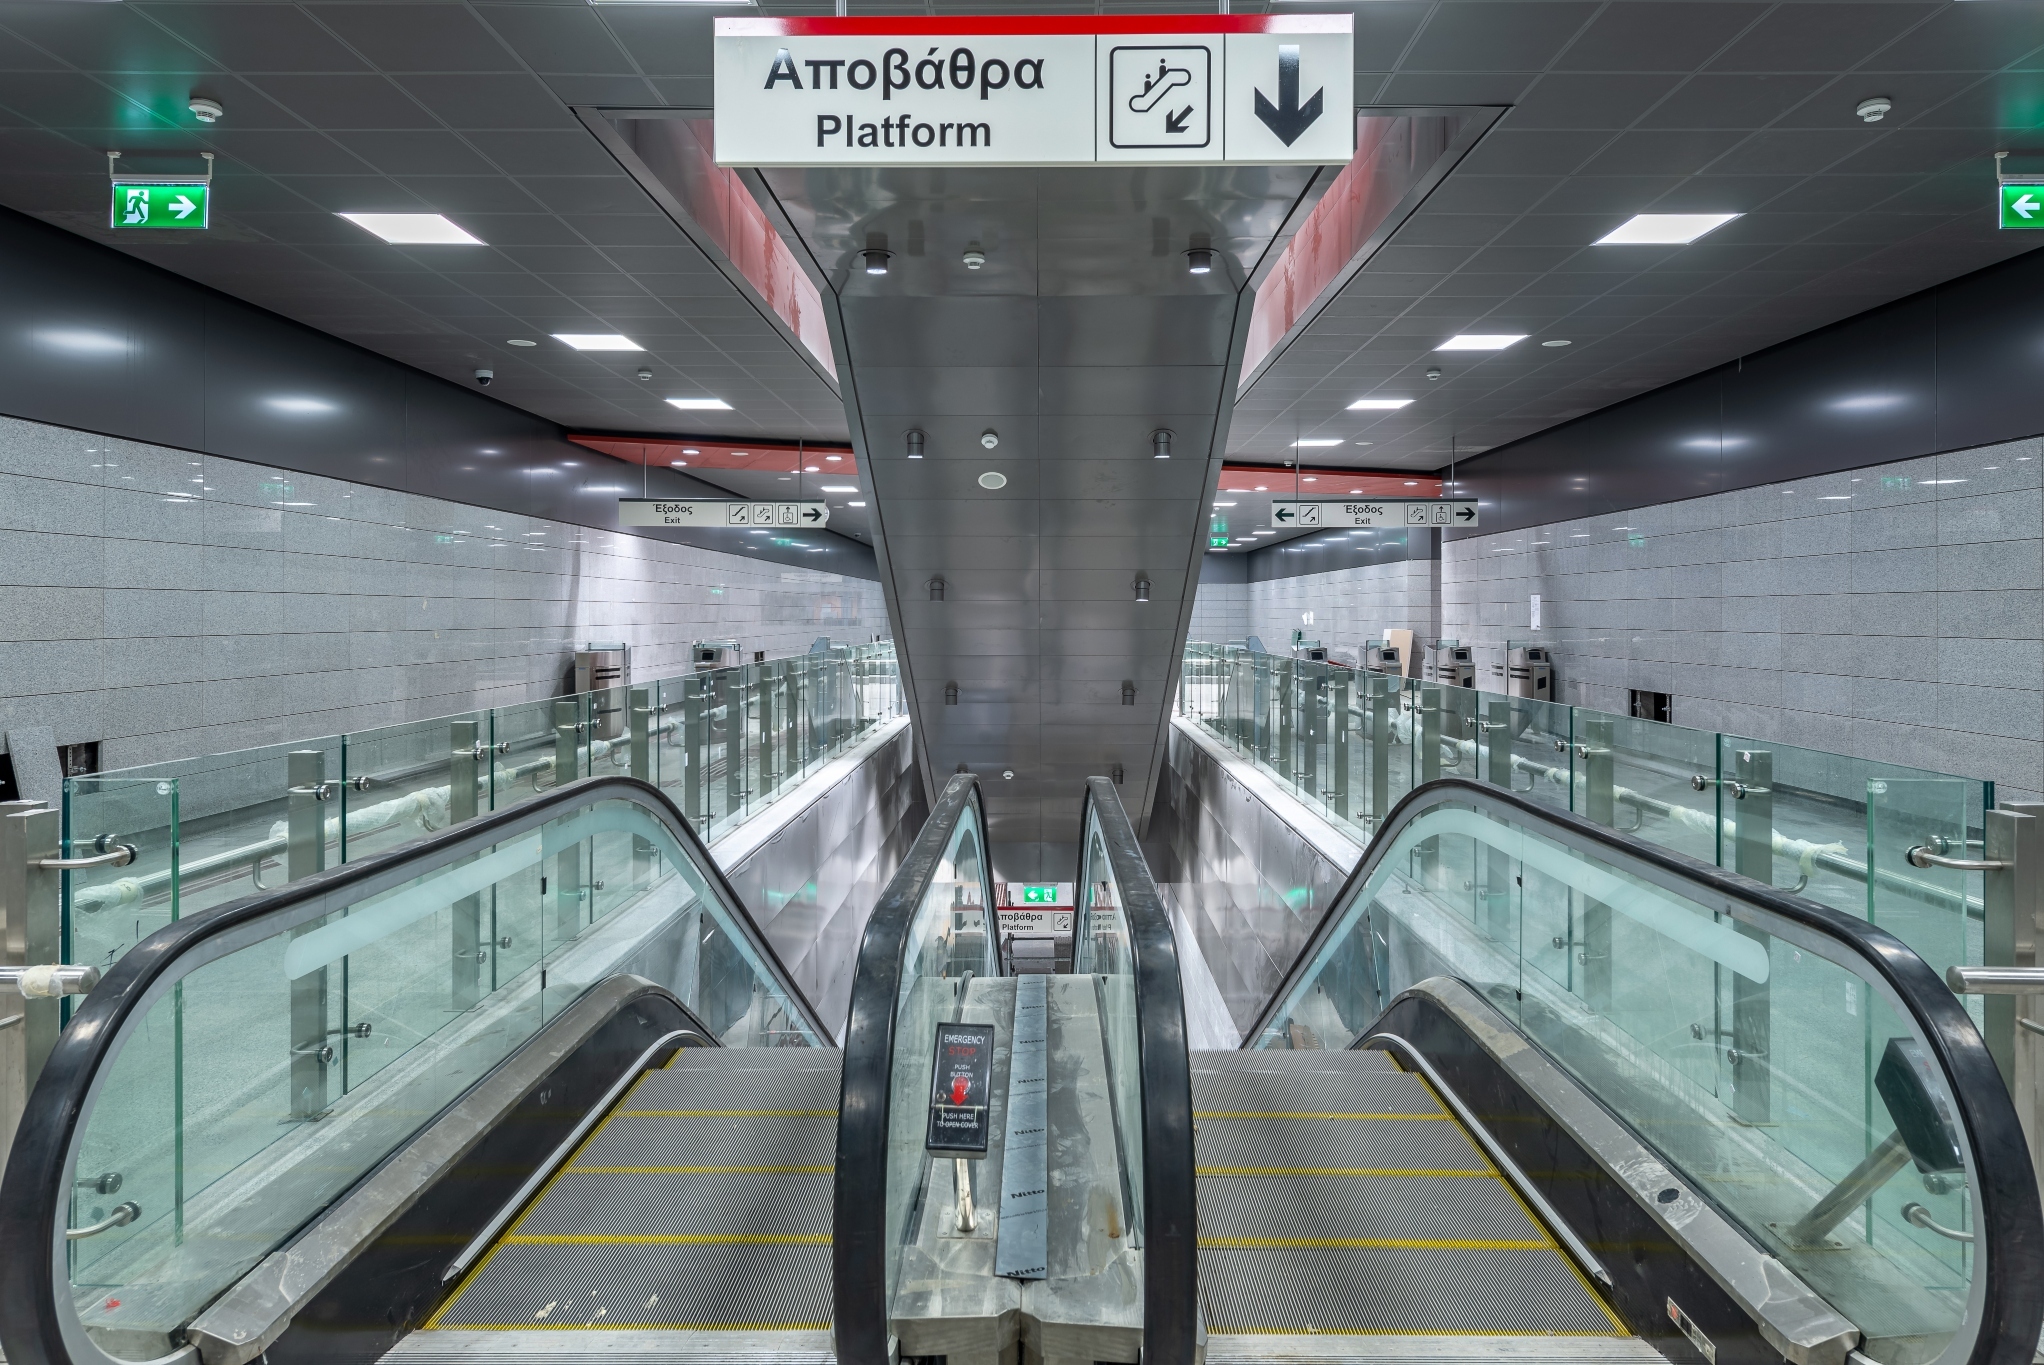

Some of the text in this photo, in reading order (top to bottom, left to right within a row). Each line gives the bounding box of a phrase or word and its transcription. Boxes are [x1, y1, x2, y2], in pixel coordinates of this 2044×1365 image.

[764, 47, 1045, 101] Αποβάθρα
[816, 114, 991, 148] Platform
[653, 504, 693, 515] Έξοδος
[1343, 505, 1383, 515] Έξοδος
[664, 516, 681, 524] Exit
[1354, 517, 1371, 525] Exit
[944, 1034, 986, 1045] EMERGENCY
[948, 1046, 977, 1056] STOP
[960, 1121, 979, 1129] COVER
[1014, 1128, 1045, 1136] Nitto
[1010, 1188, 1045, 1199] Nitto
[1006, 1266, 1046, 1277] Nitto
